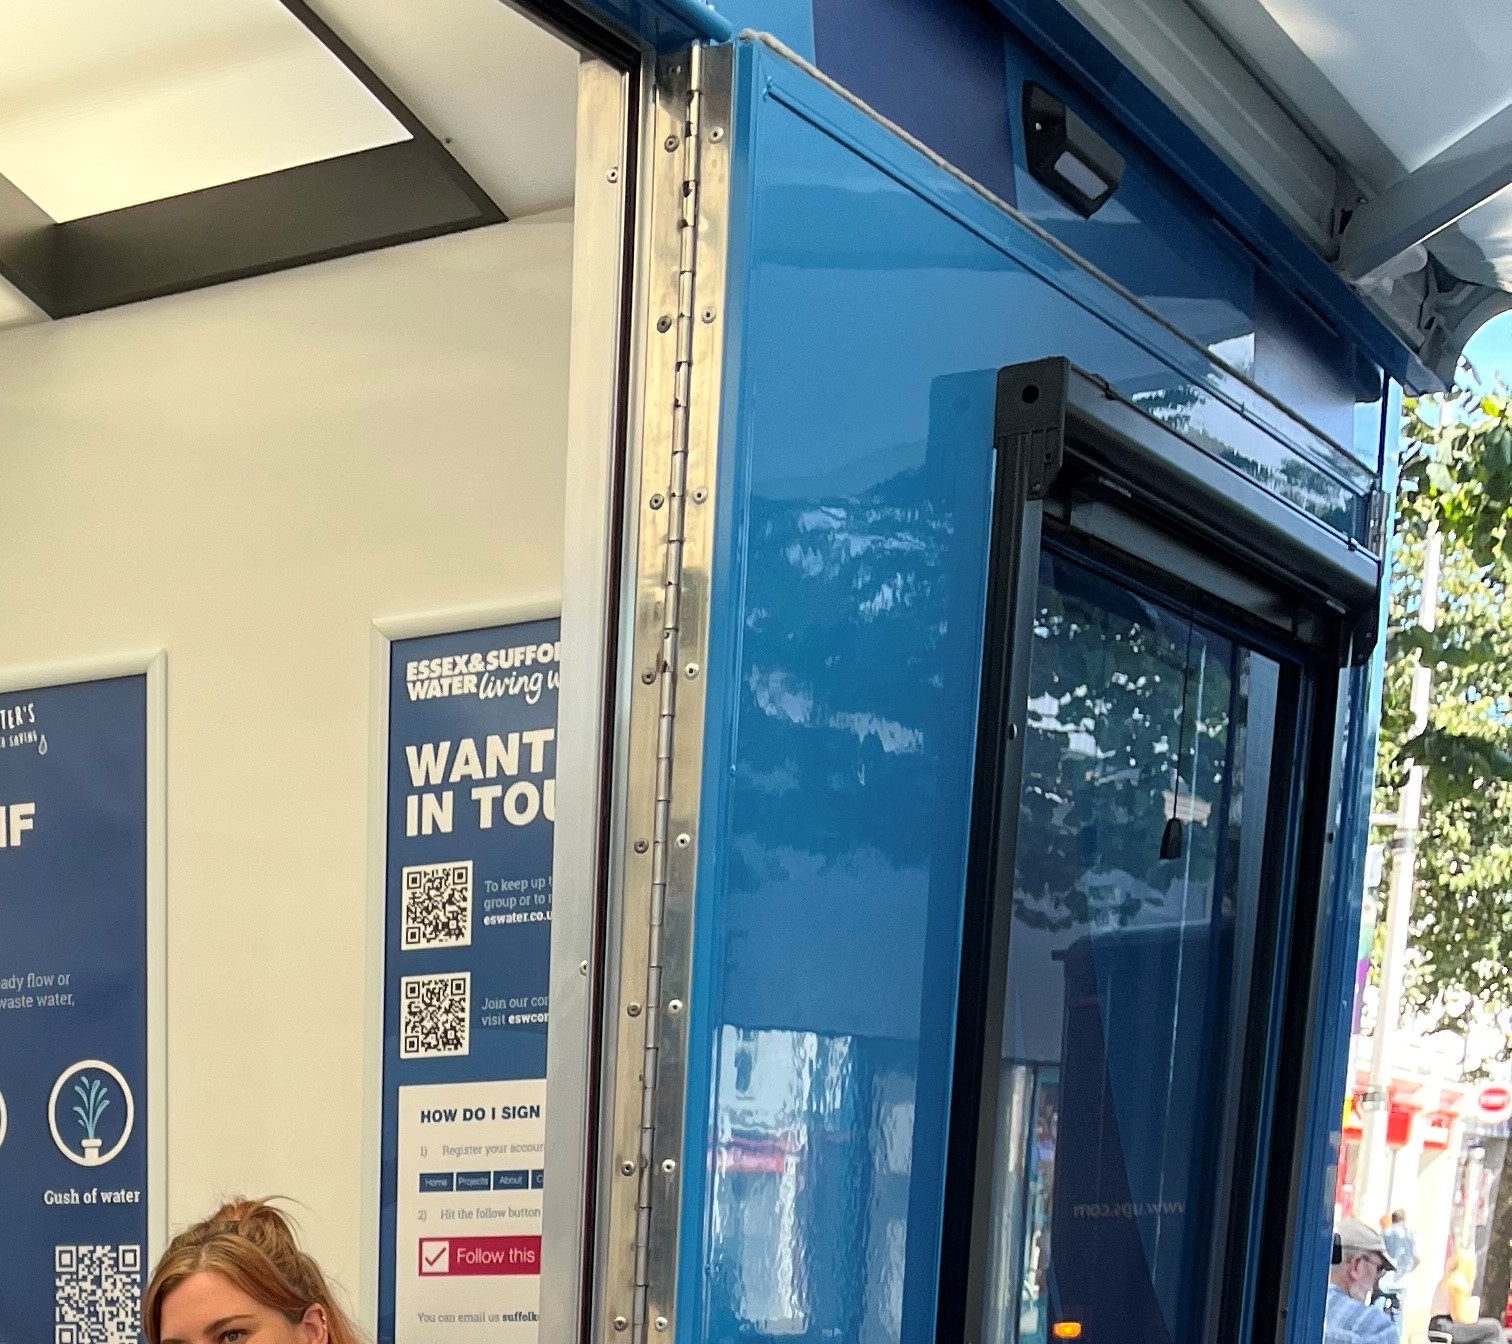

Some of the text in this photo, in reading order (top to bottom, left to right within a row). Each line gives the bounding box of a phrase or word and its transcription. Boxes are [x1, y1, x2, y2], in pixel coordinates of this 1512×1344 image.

[406, 673, 478, 702] WATER
[478, 671, 544, 705] living
[405, 728, 555, 787] WANT
[406, 790, 454, 837] IN
[484, 879, 499, 892] To
[501, 878, 529, 892] keep
[531, 877, 546, 891] up
[484, 895, 517, 912] group
[519, 895, 531, 907] or
[534, 893, 546, 905] to
[27, 972, 55, 988] flow
[57, 973, 71, 985] or
[36, 993, 75, 1007] water,
[481, 997, 507, 1011] Join
[509, 996, 528, 1009] our
[481, 1013, 506, 1026] visit
[420, 1105, 541, 1124] HOW DO I SIGN
[442, 1144, 482, 1158] Register
[485, 1143, 508, 1157] your
[43, 1187, 141, 1206] Gush of water
[441, 1208, 456, 1220] Hit
[458, 1207, 473, 1219] the
[476, 1207, 506, 1219] follow
[508, 1206, 541, 1218] button
[456, 1246, 536, 1264] Follow this
[502, 1311, 540, 1322] suffolk
